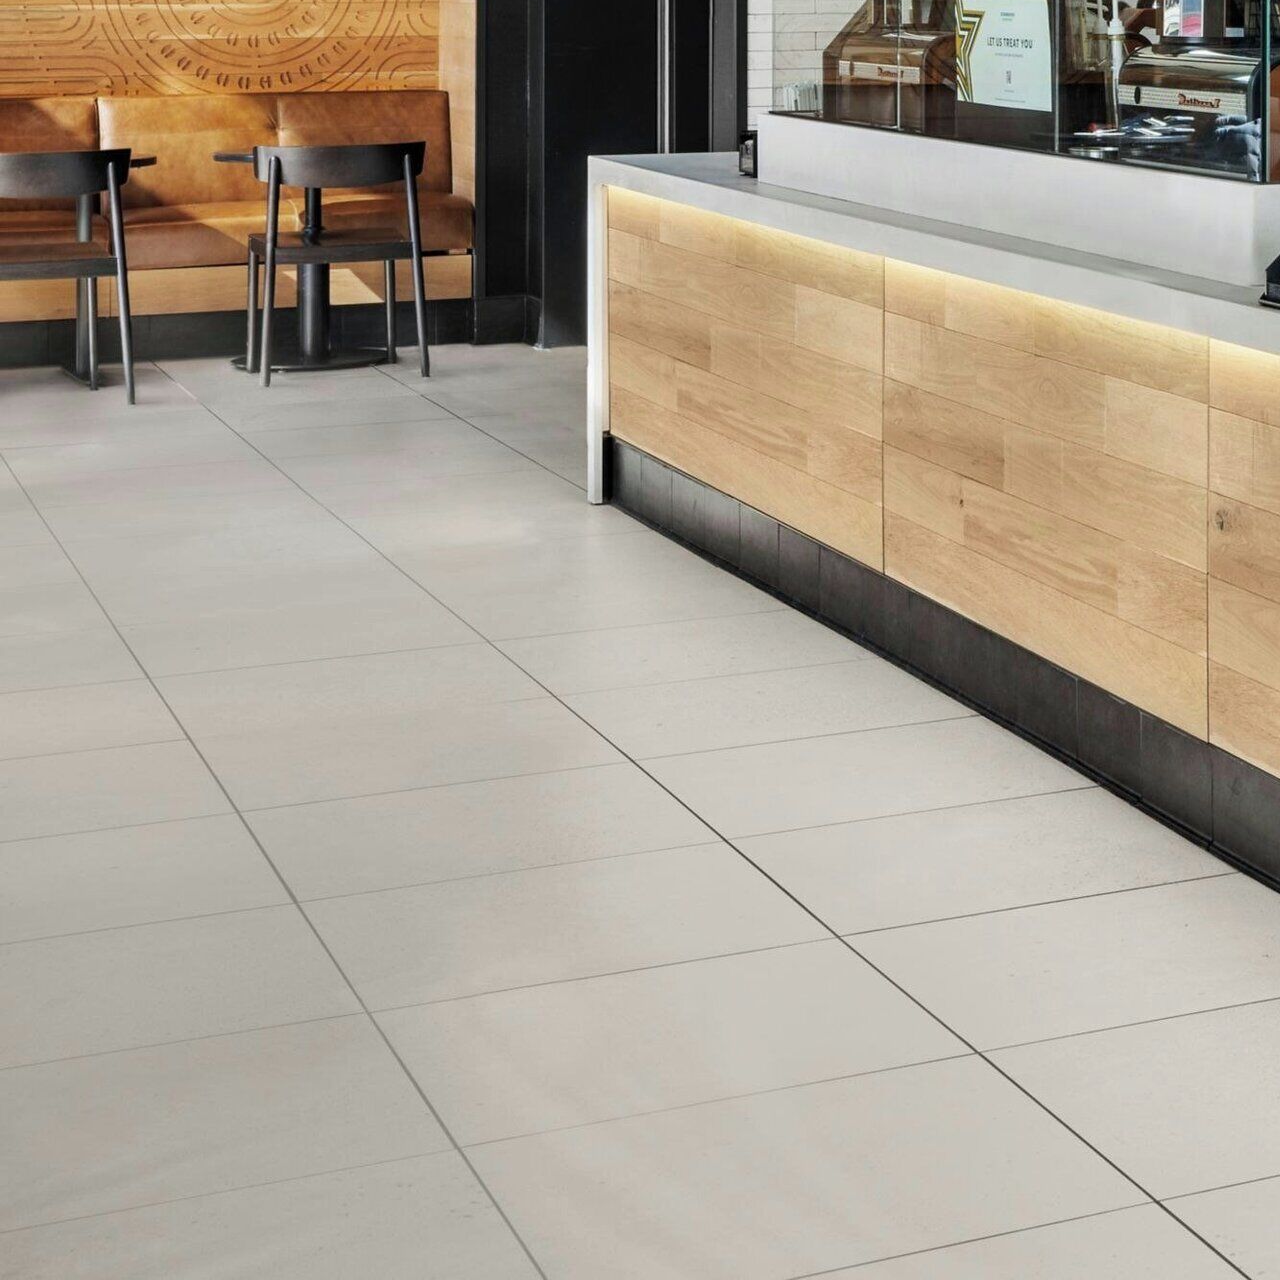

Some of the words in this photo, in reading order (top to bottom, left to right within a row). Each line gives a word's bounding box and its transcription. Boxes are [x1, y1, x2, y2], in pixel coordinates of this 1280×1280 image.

[987, 37, 995, 46] LET
[996, 38, 1002, 47] US
[1003, 38, 1019, 48] TREAT
[1021, 39, 1033, 49] YOU
